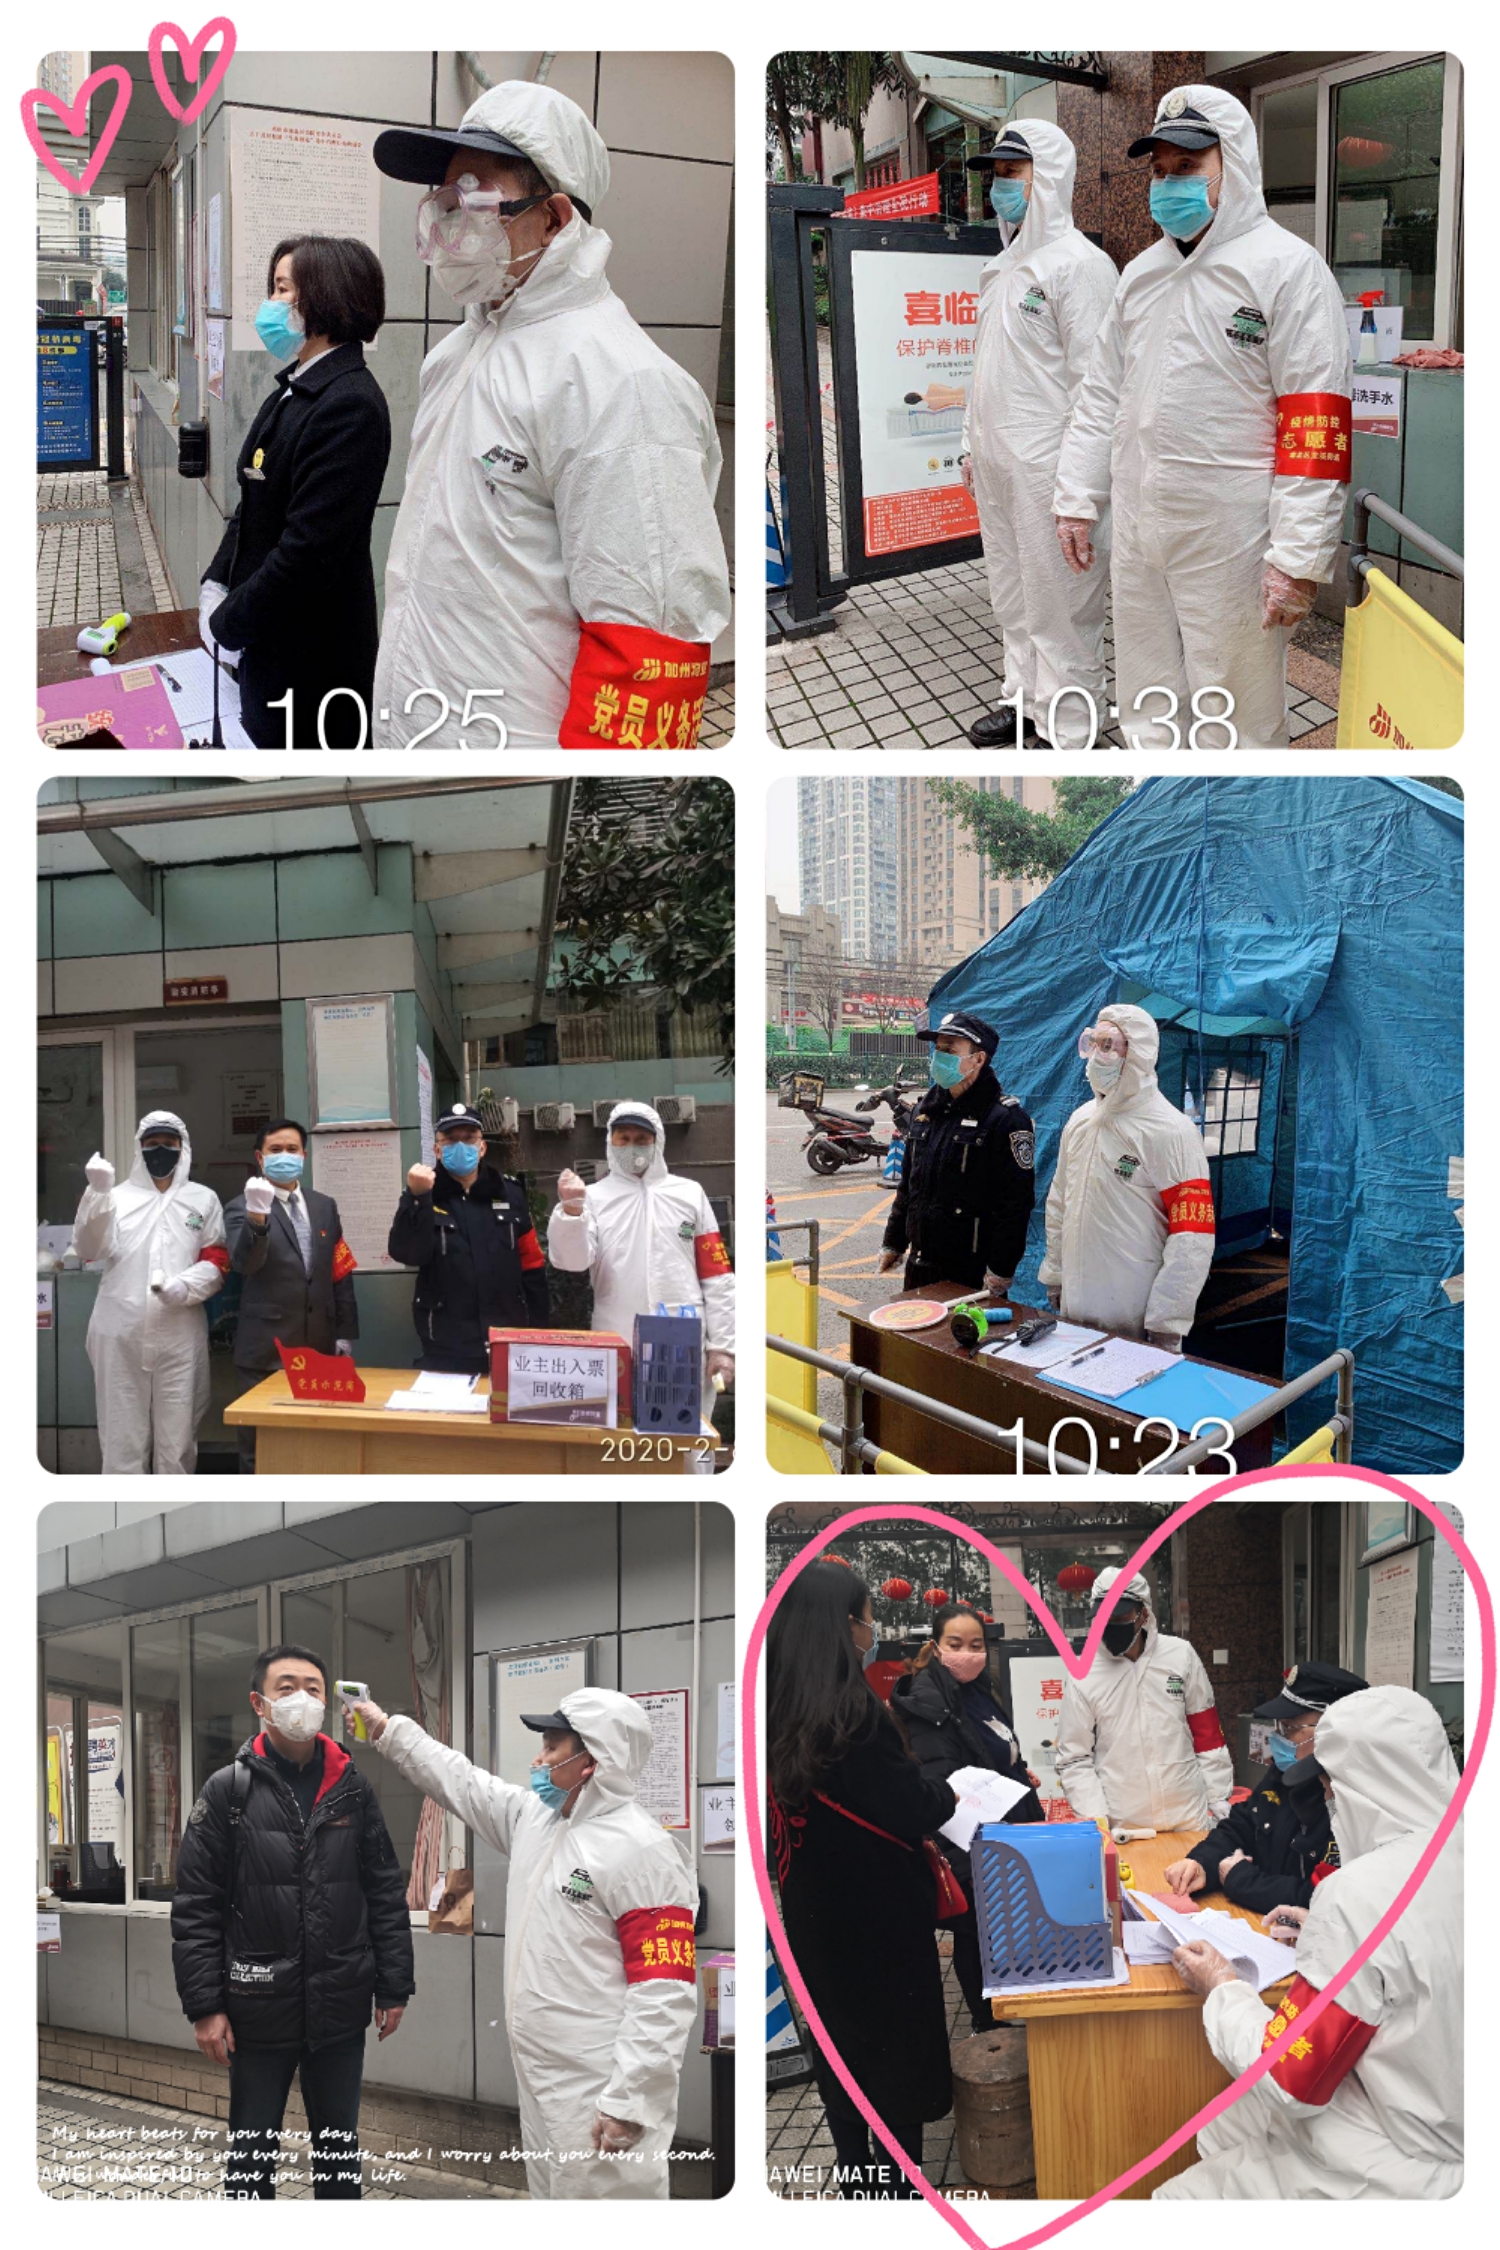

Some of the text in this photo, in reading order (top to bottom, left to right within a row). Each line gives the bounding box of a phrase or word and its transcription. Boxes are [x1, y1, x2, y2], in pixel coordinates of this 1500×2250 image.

[904, 290, 980, 326] 喜临
[896, 337, 977, 358] 保护脊椎
[1281, 431, 1348, 452] 志愿者
[513, 1355, 606, 1378] 业主出入票
[532, 1381, 586, 1401] 回收箱
[1040, 1678, 1064, 1701] 喜
[641, 1937, 696, 1969] 党员义务
